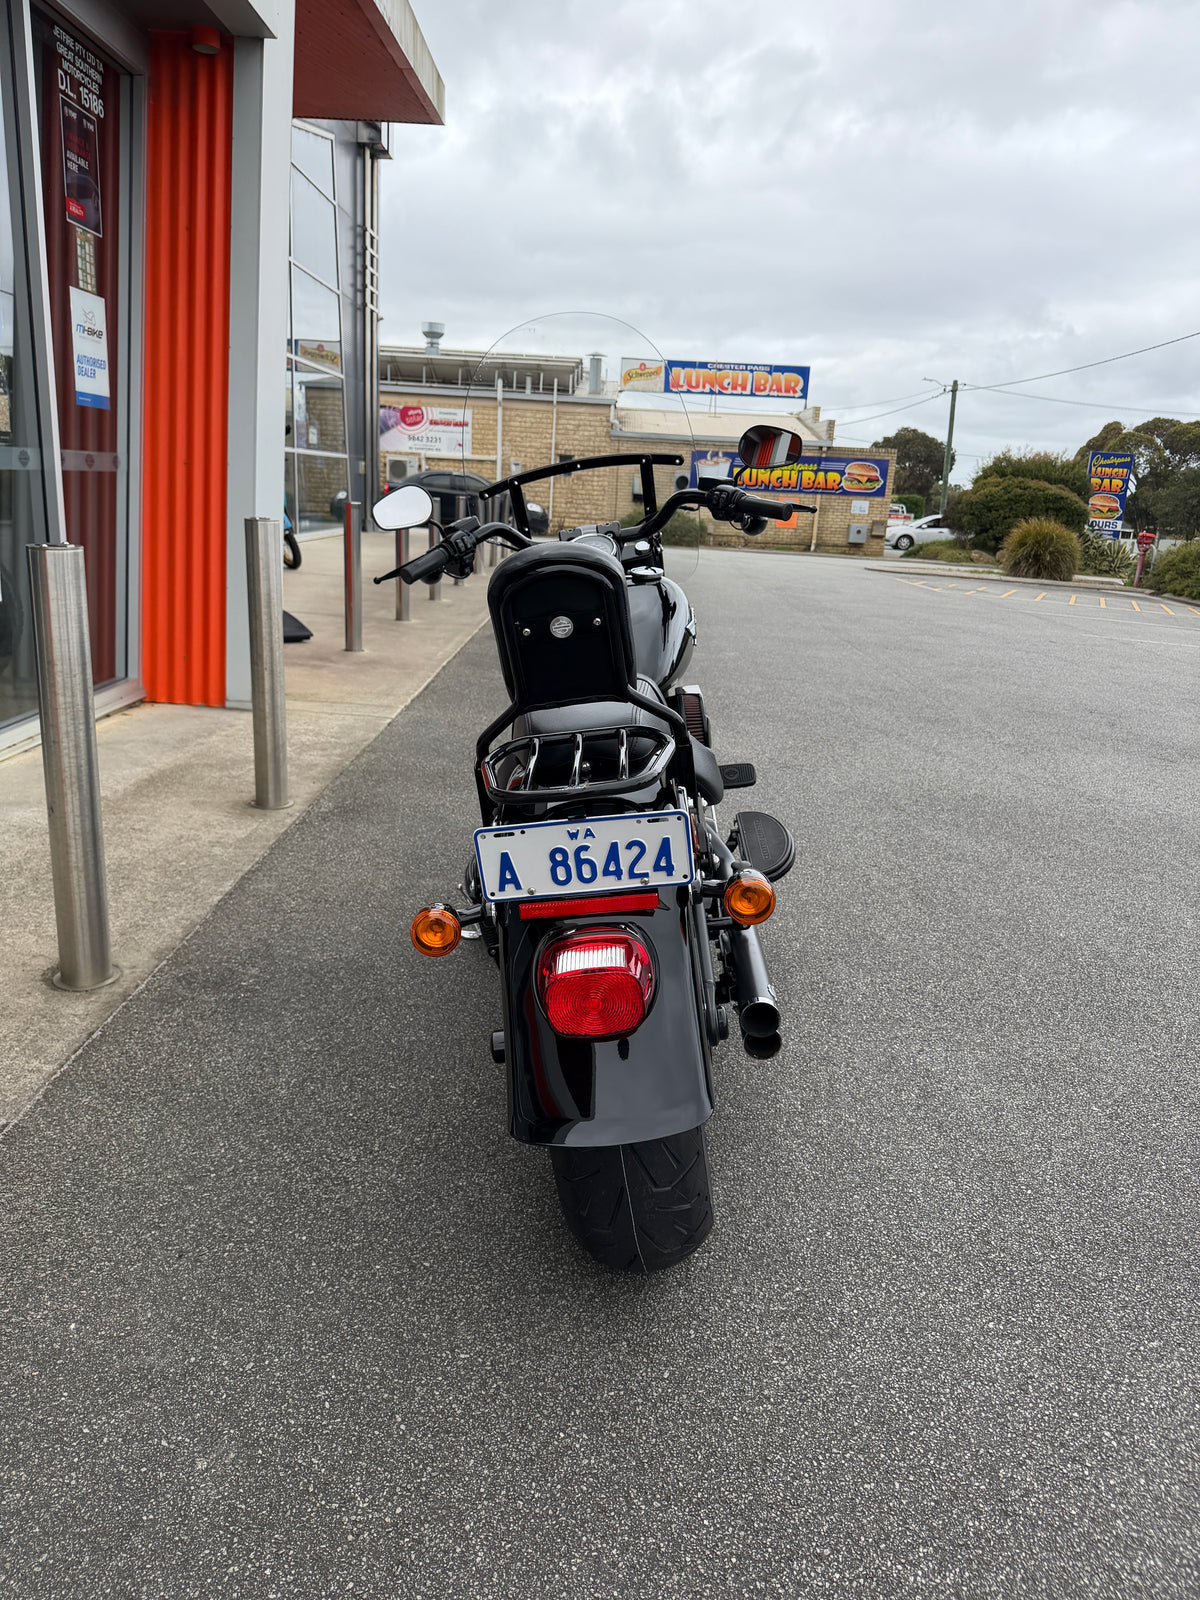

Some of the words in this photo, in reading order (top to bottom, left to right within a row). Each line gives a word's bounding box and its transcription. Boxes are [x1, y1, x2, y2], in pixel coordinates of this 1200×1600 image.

[56, 41, 74, 63] GREAT
[75, 55, 103, 85] SOUTHERN
[75, 42, 86, 58] PTY
[86, 51, 96, 66] LTD
[62, 58, 100, 94] MOTORCYCLES
[79, 85, 105, 119] 15186
[66, 149, 89, 170] AVAILABLE
[66, 160, 79, 174] HERE
[77, 354, 106, 370] AUTHORISED
[78, 366, 96, 378] DEALER
[707, 362, 746, 372] CHESTER
[747, 364, 771, 372] PASS
[670, 367, 752, 395] LUNCH
[752, 371, 804, 397] BAR
[800, 470, 843, 492] BAR
[1091, 466, 1128, 478] LUNCH
[1090, 477, 1124, 493] BAR
[566, 827, 596, 841] WA
[498, 850, 523, 892] A
[548, 835, 675, 887] 86424
